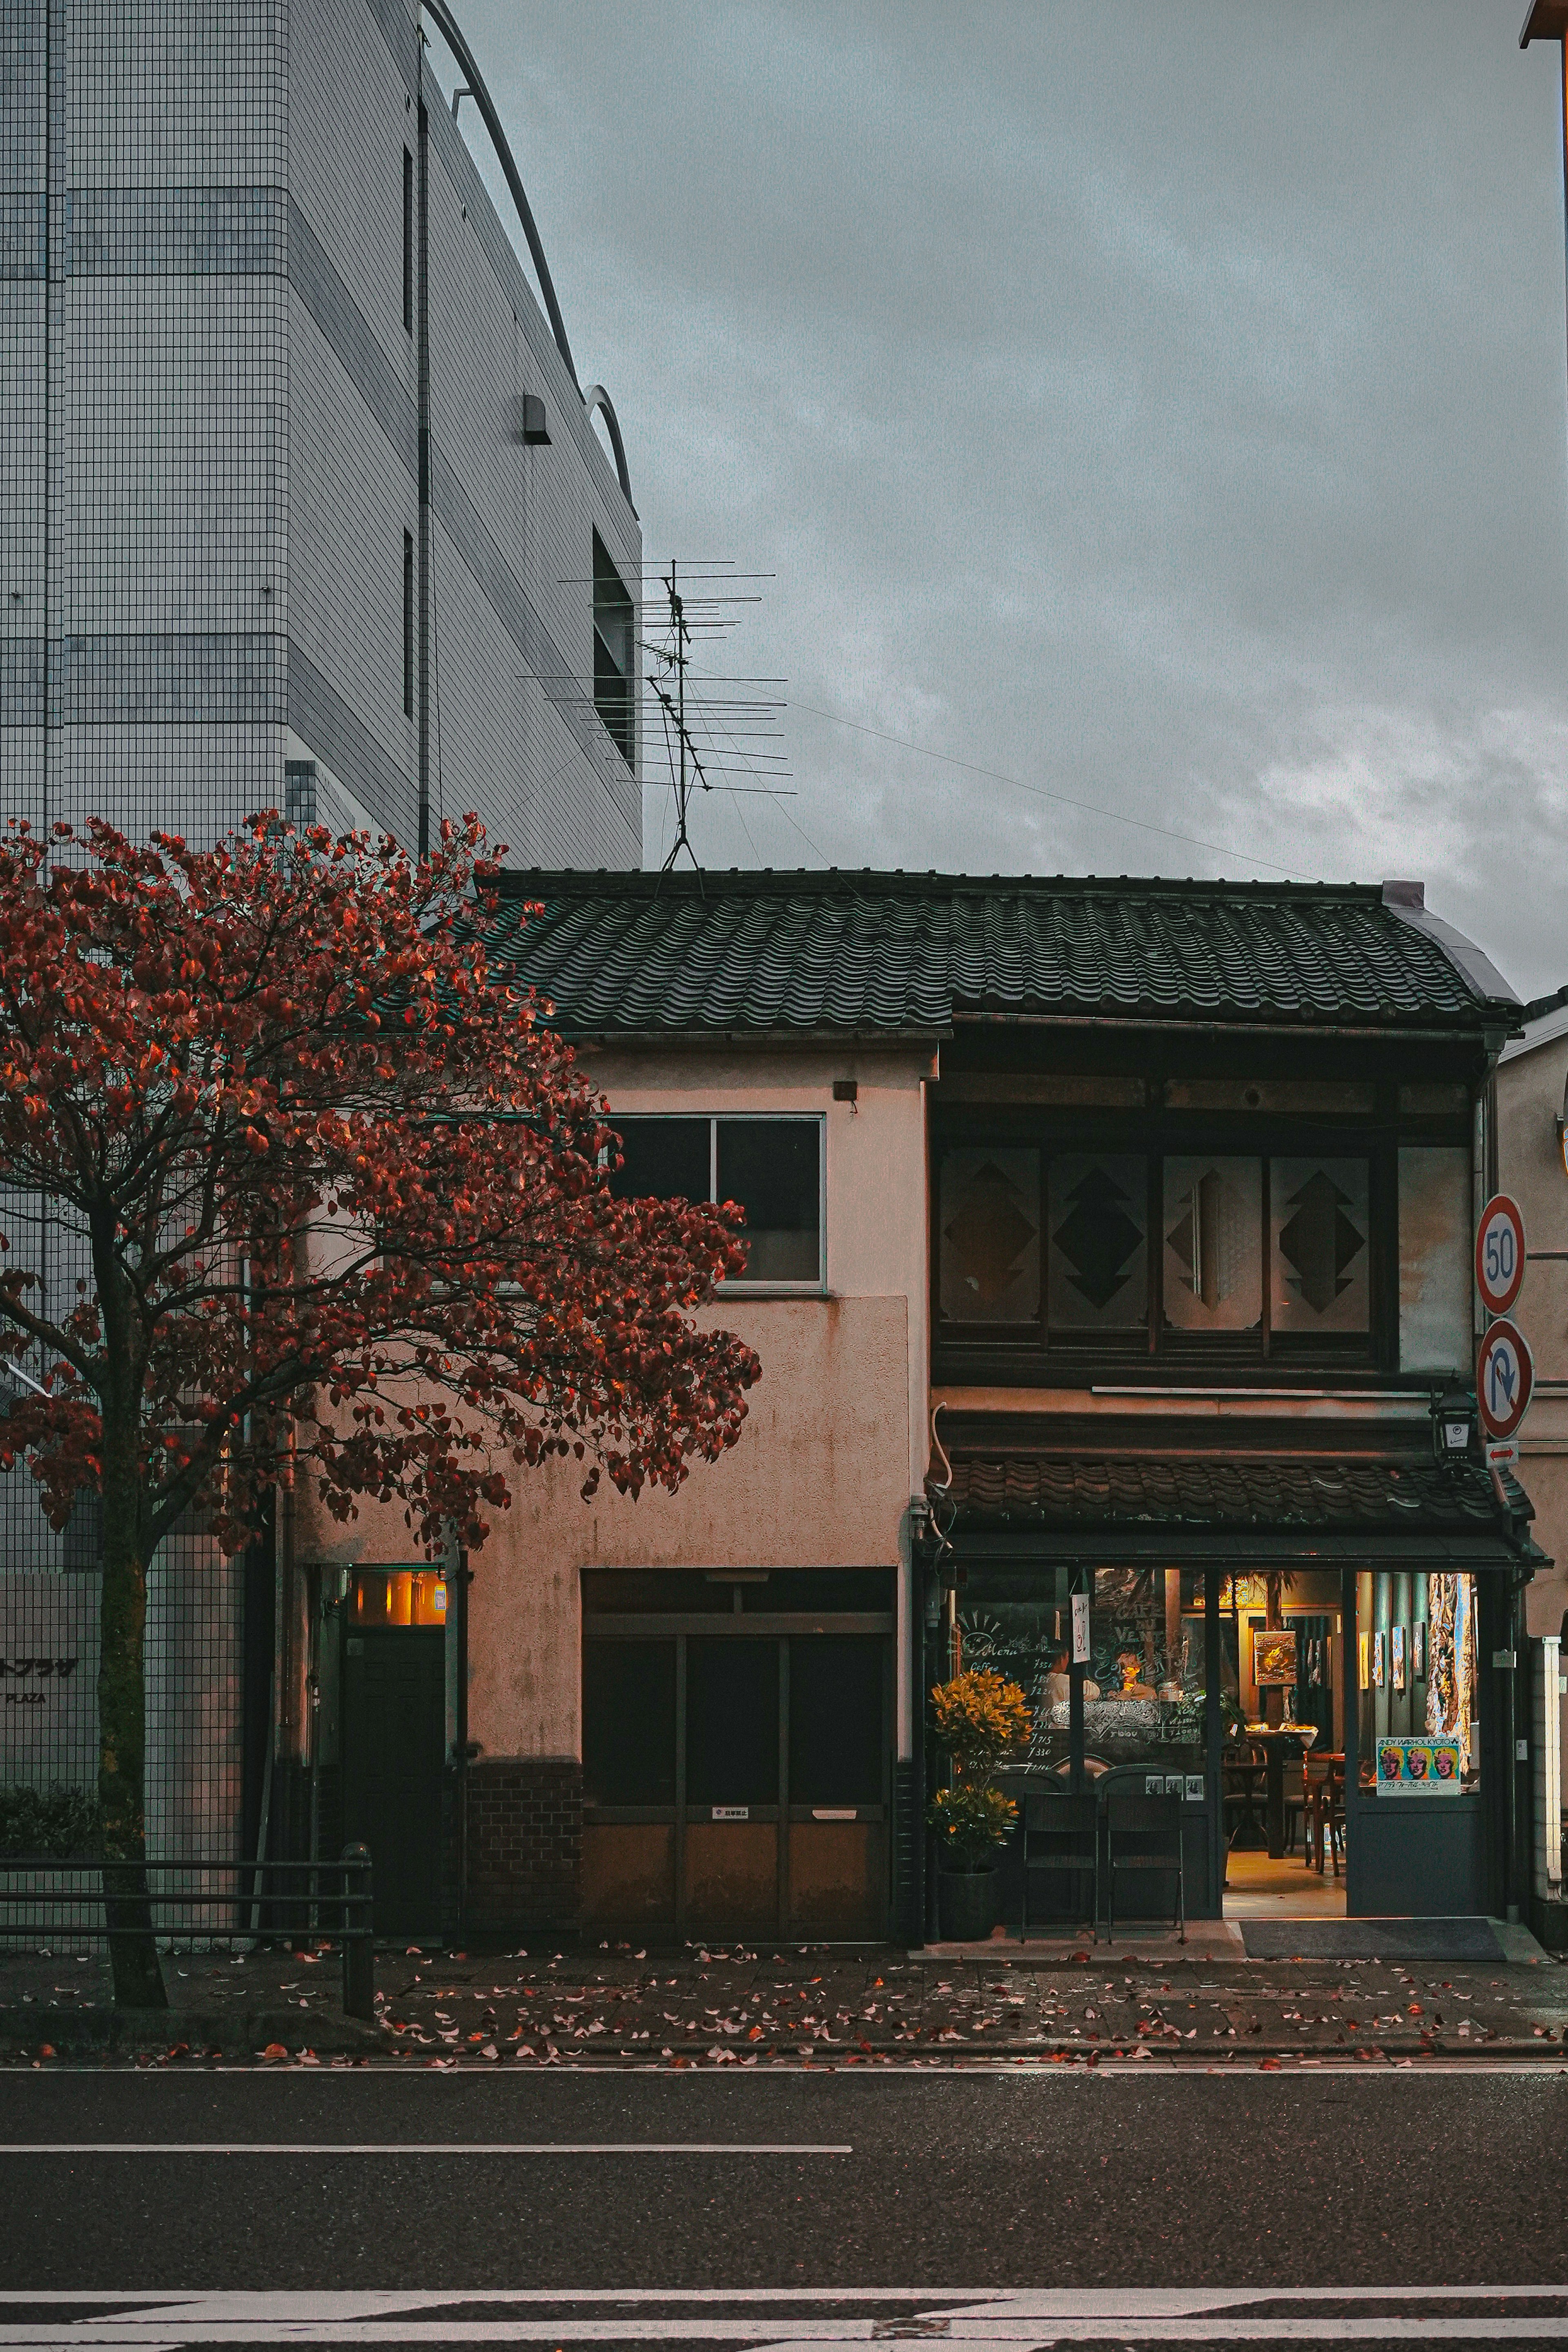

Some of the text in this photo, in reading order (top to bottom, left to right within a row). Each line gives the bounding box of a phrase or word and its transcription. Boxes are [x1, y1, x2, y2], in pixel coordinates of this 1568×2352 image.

[1487, 1228, 1513, 1281] 50
[978, 1641, 1018, 1656] Menu
[7, 1693, 46, 1704] PLAZA
